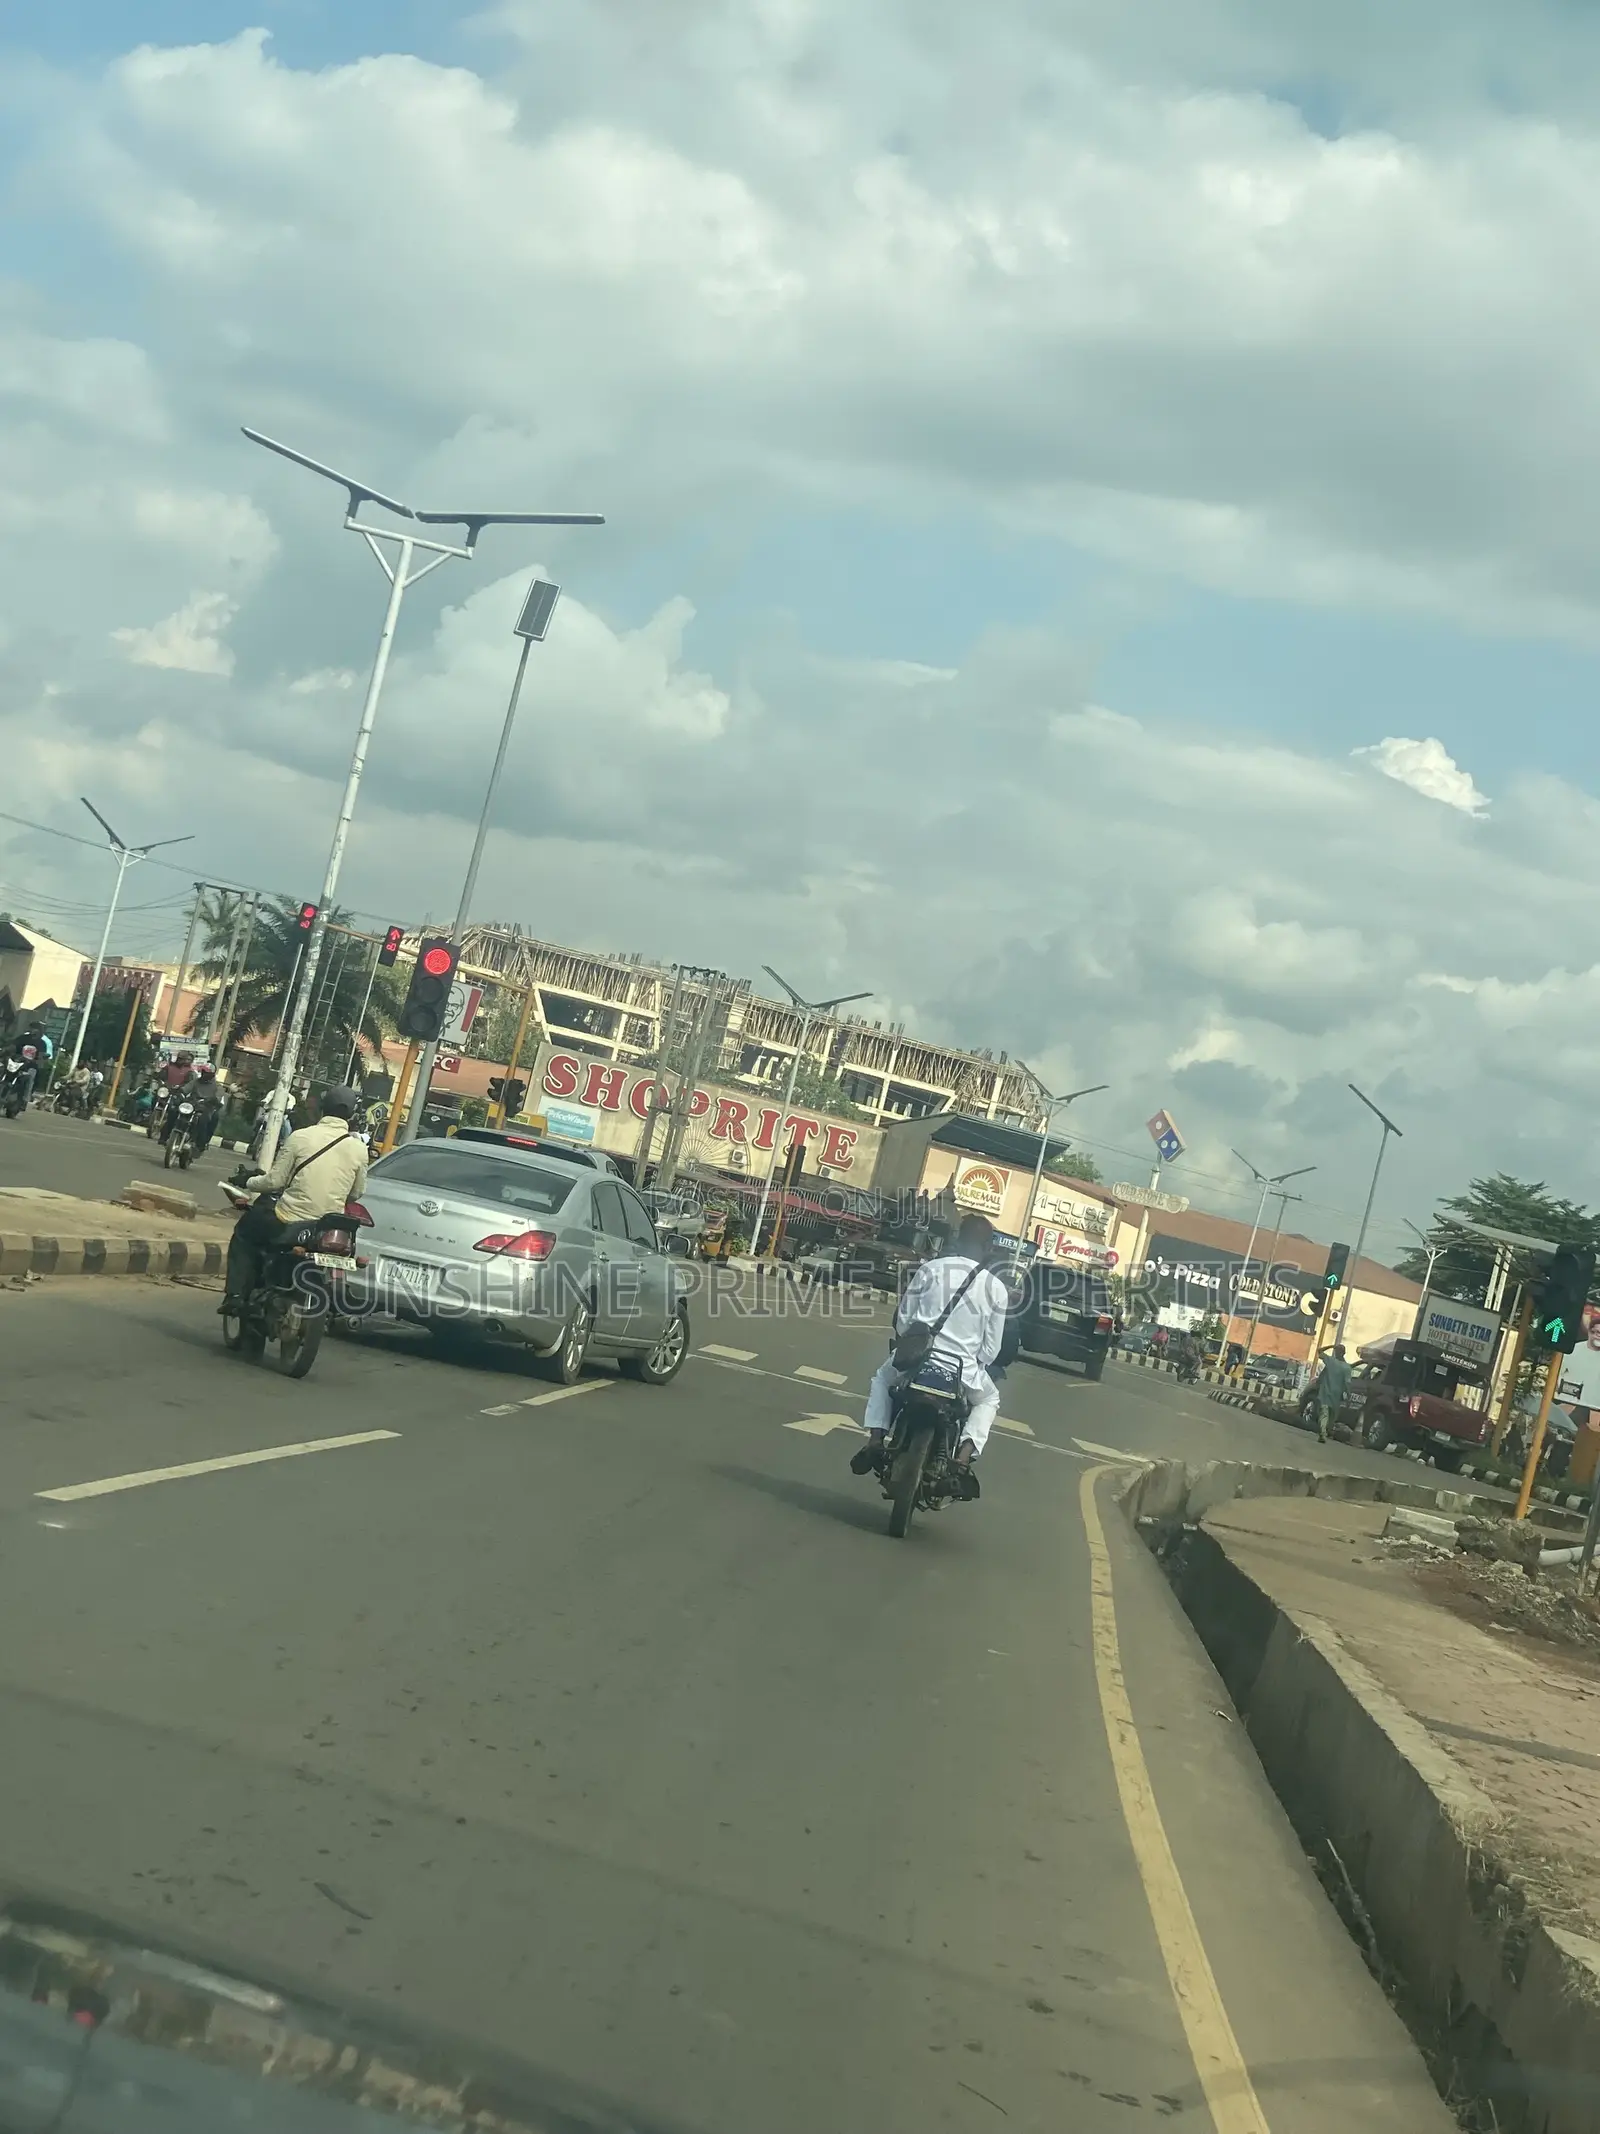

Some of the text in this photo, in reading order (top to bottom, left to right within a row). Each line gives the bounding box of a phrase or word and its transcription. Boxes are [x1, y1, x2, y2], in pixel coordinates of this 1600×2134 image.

[543, 1053, 858, 1171] SHOPRITE
[1173, 1263, 1221, 1290] Pizza
[1229, 1273, 1300, 1307] COLD STONE
[1429, 1312, 1492, 1342] SUNBETH STAR
